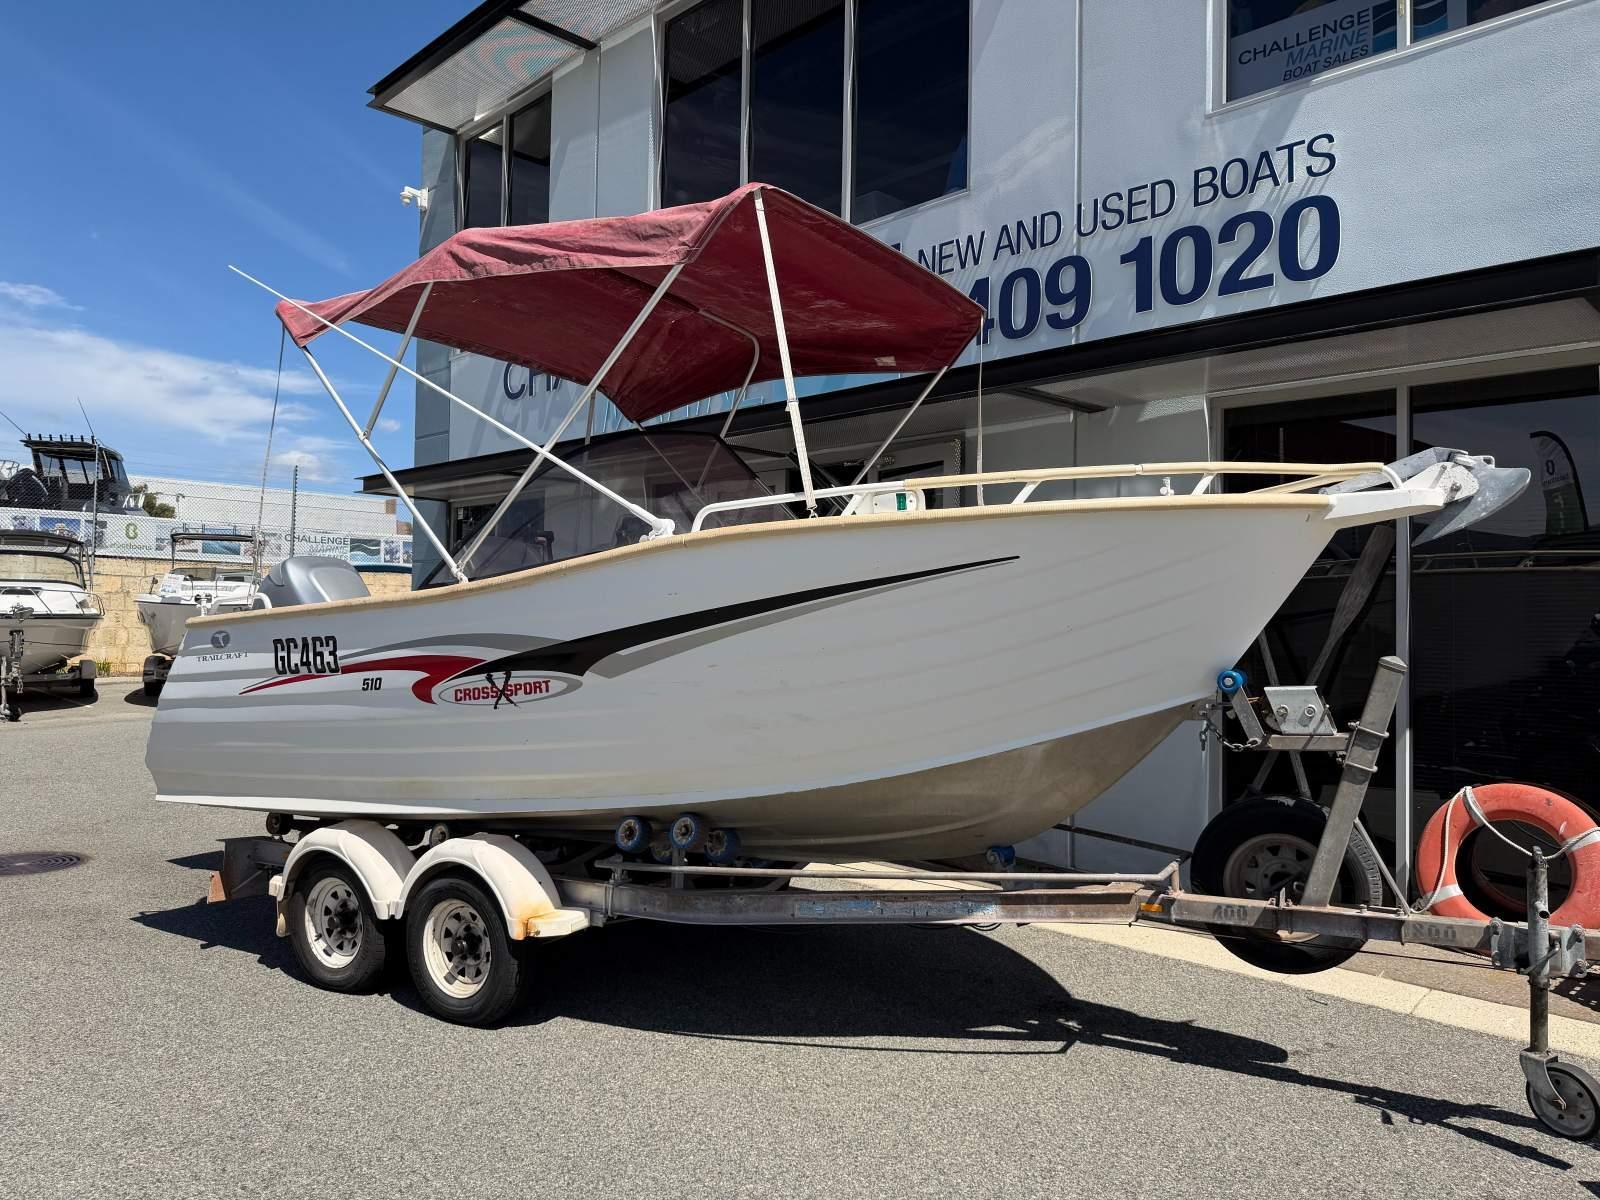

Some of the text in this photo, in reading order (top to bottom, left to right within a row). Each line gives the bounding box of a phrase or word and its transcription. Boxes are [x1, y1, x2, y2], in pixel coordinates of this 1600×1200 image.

[1238, 8, 1371, 65] CHALLENGE
[1286, 26, 1369, 67] MARINE
[1283, 45, 1369, 81] BOAT SALES
[918, 133, 1336, 275] NEW AND USED BOATS
[1120, 195, 1341, 314] 1020
[284, 533, 350, 546] CHALLENGE
[197, 652, 249, 662] TRAILCRAFT
[273, 635, 339, 675] GC463
[361, 677, 382, 691] 510
[454, 687, 501, 702] CROSS
[503, 679, 551, 697] SPORT
